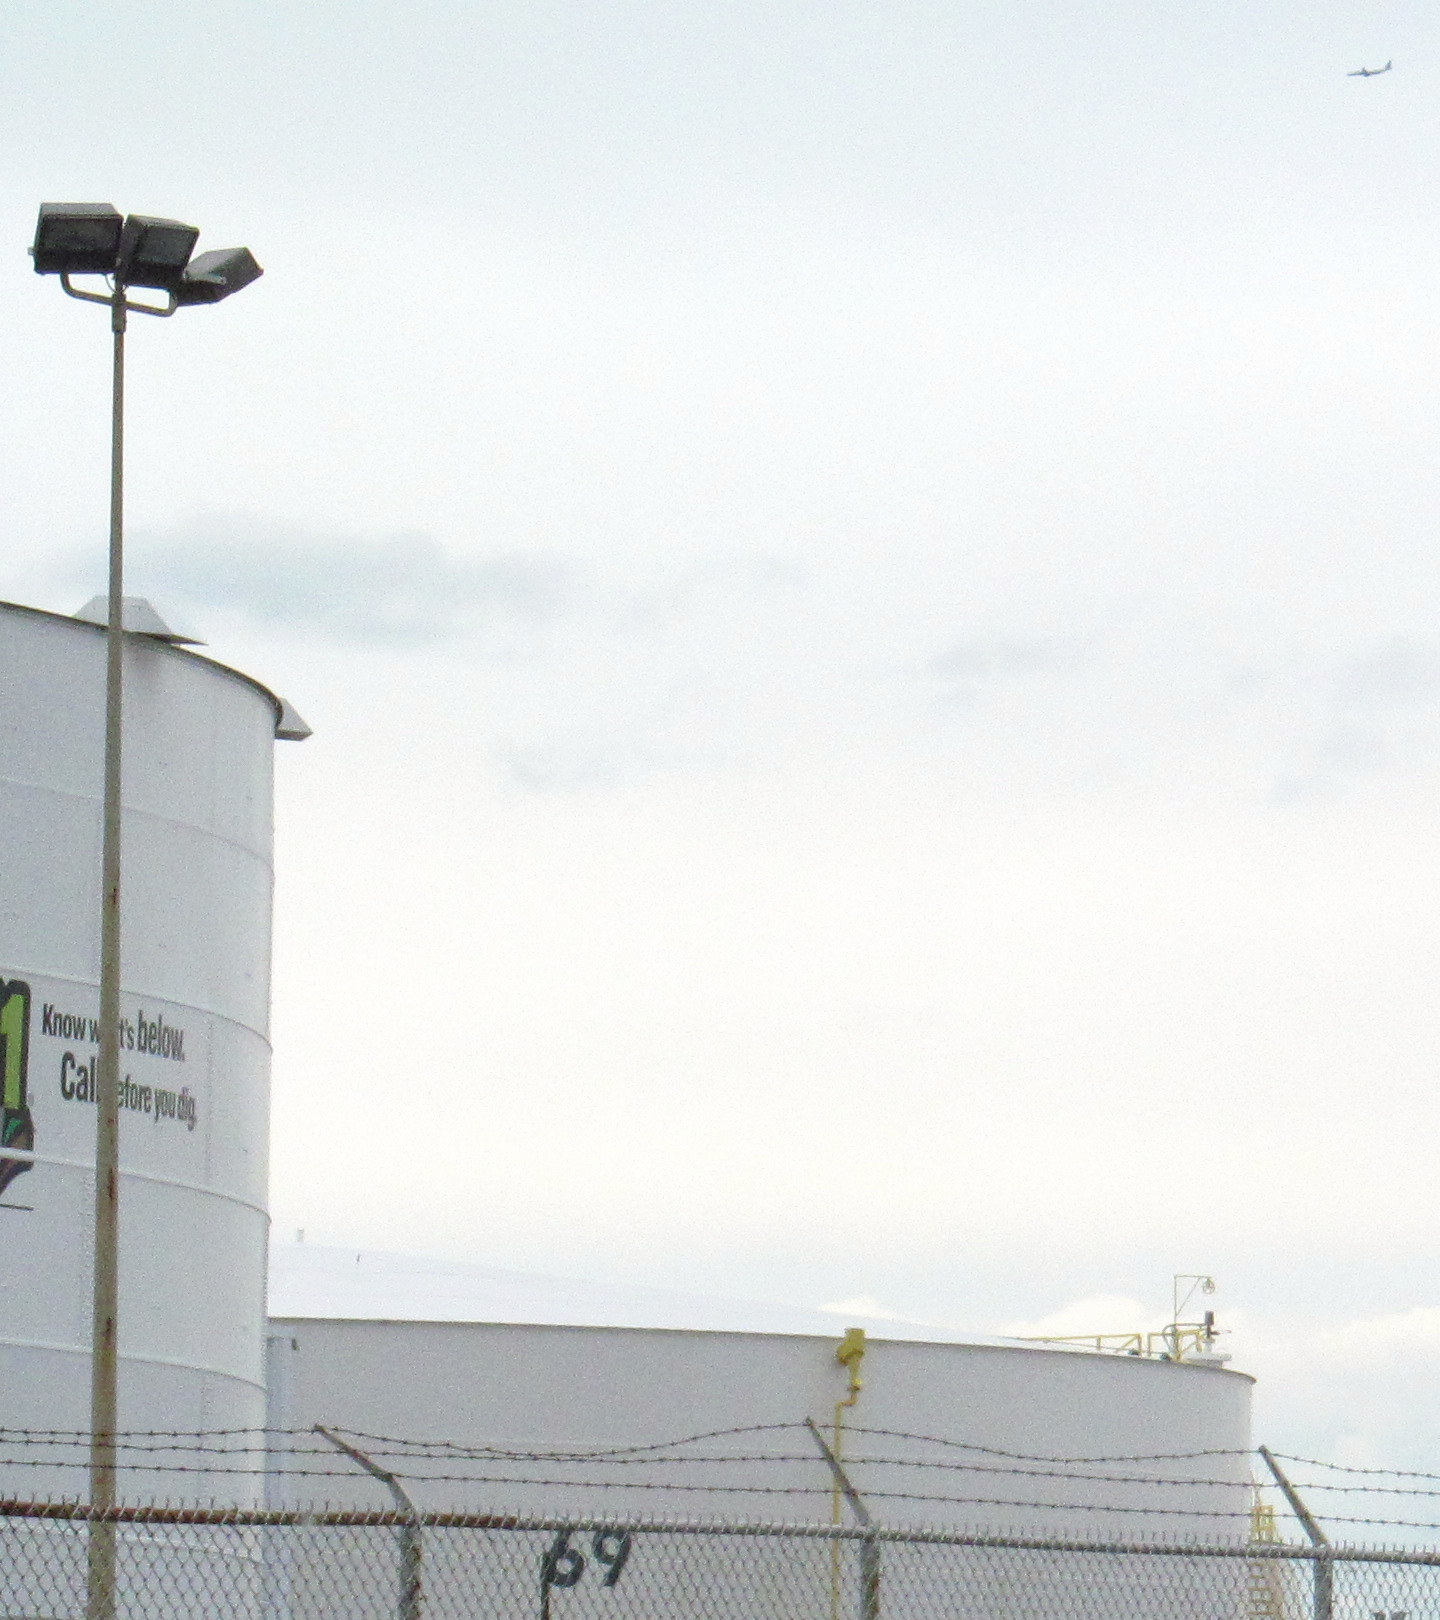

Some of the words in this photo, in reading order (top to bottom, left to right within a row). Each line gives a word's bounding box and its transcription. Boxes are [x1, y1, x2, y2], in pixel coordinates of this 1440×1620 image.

[42, 1003, 86, 1042] Know
[89, 1018, 135, 1050] wt's
[115, 1074, 151, 1113] efore
[154, 1091, 175, 1124] you
[544, 1528, 632, 1588] 69
